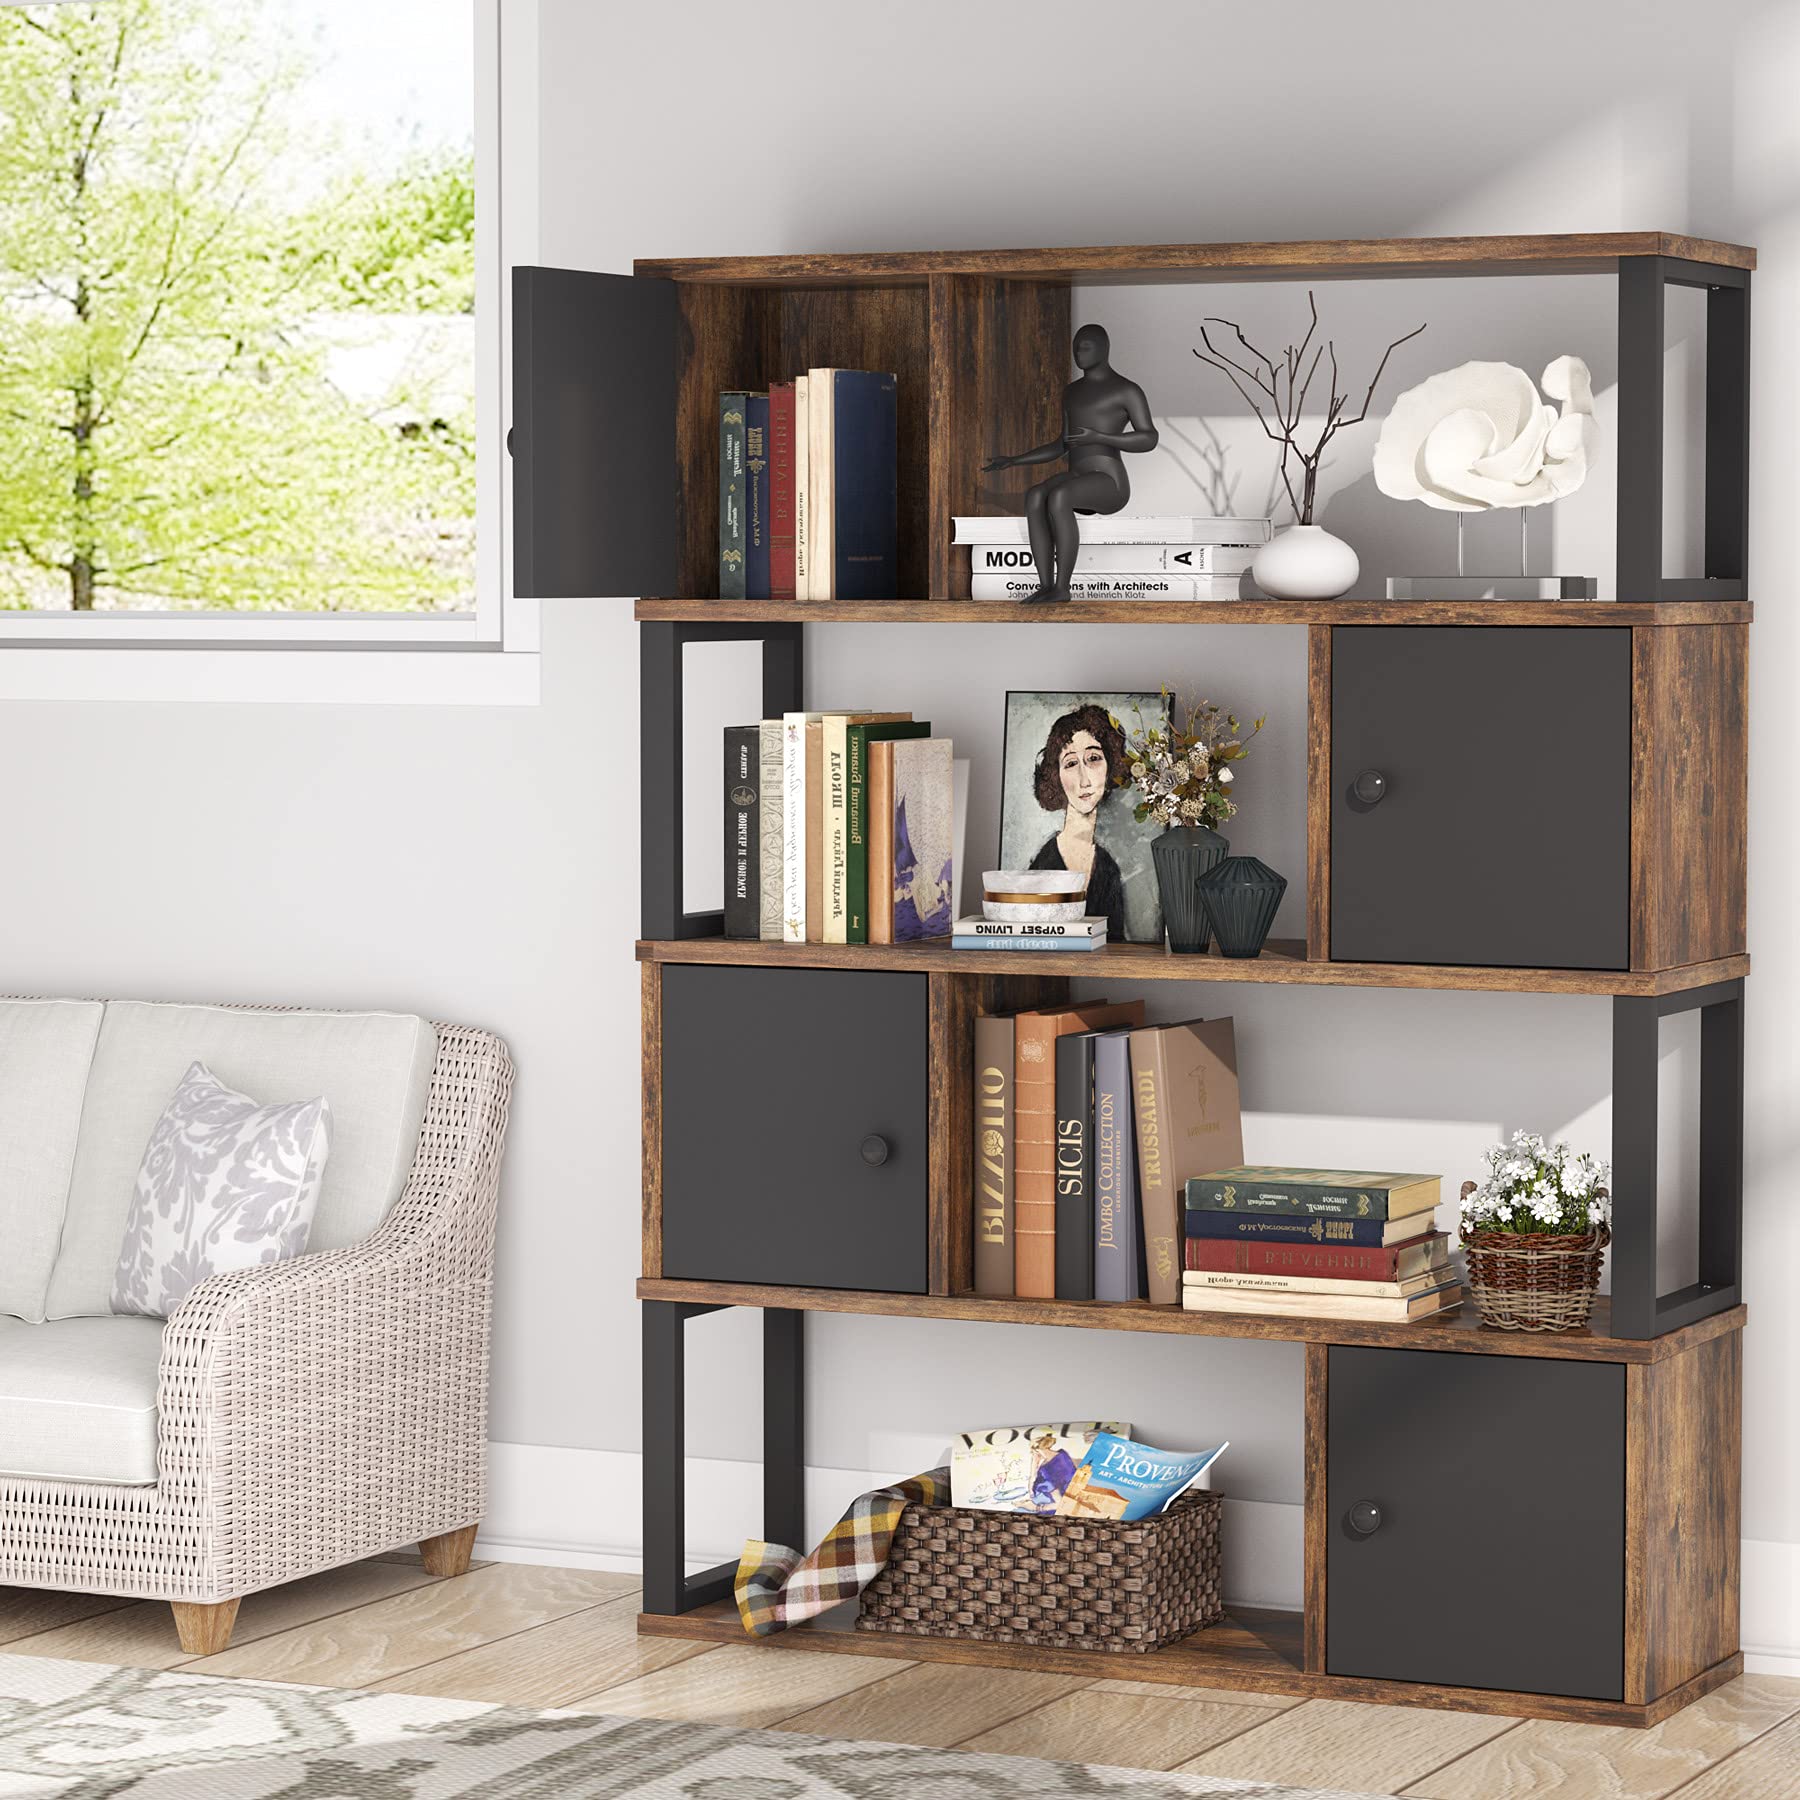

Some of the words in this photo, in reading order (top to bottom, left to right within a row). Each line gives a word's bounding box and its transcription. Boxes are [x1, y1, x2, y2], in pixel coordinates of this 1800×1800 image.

[1174, 550, 1192, 566] A
[1088, 582, 1110, 590] with
[1113, 582, 1168, 591] Architects
[976, 925, 1012, 934] LIVING
[1020, 926, 1065, 935] GYPSET
[1138, 1070, 1162, 1189] TRUSSARDI
[1099, 1092, 1114, 1192] COLLECTION
[1057, 1119, 1083, 1196] SICIS
[1098, 1196, 1118, 1250] JUMBO
[1098, 1470, 1114, 1478] ART
[1118, 1476, 1162, 1489] ARCHITECTURE
